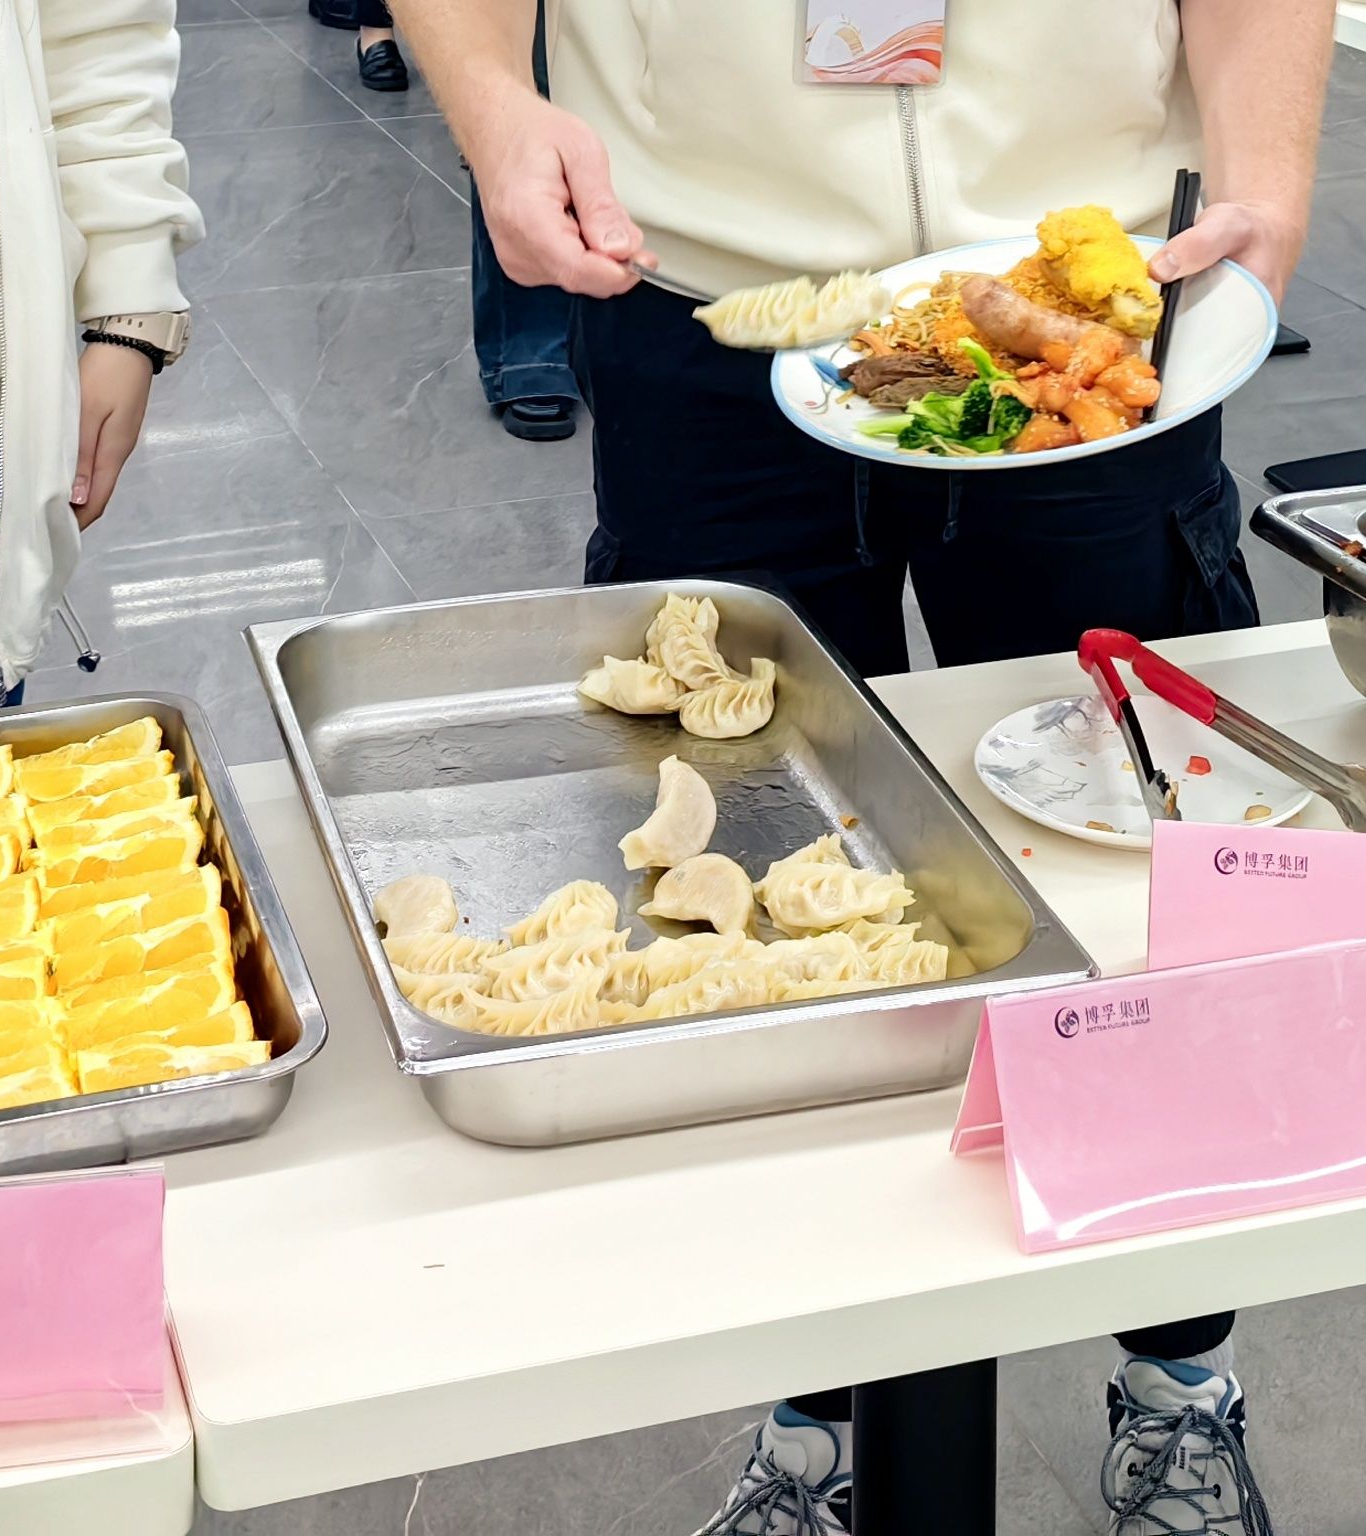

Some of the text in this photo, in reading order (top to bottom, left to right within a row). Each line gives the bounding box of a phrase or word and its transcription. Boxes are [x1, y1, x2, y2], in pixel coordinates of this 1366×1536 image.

[1244, 850, 1309, 873] 博孚集团
[1085, 997, 1150, 1025] 博孚集团
